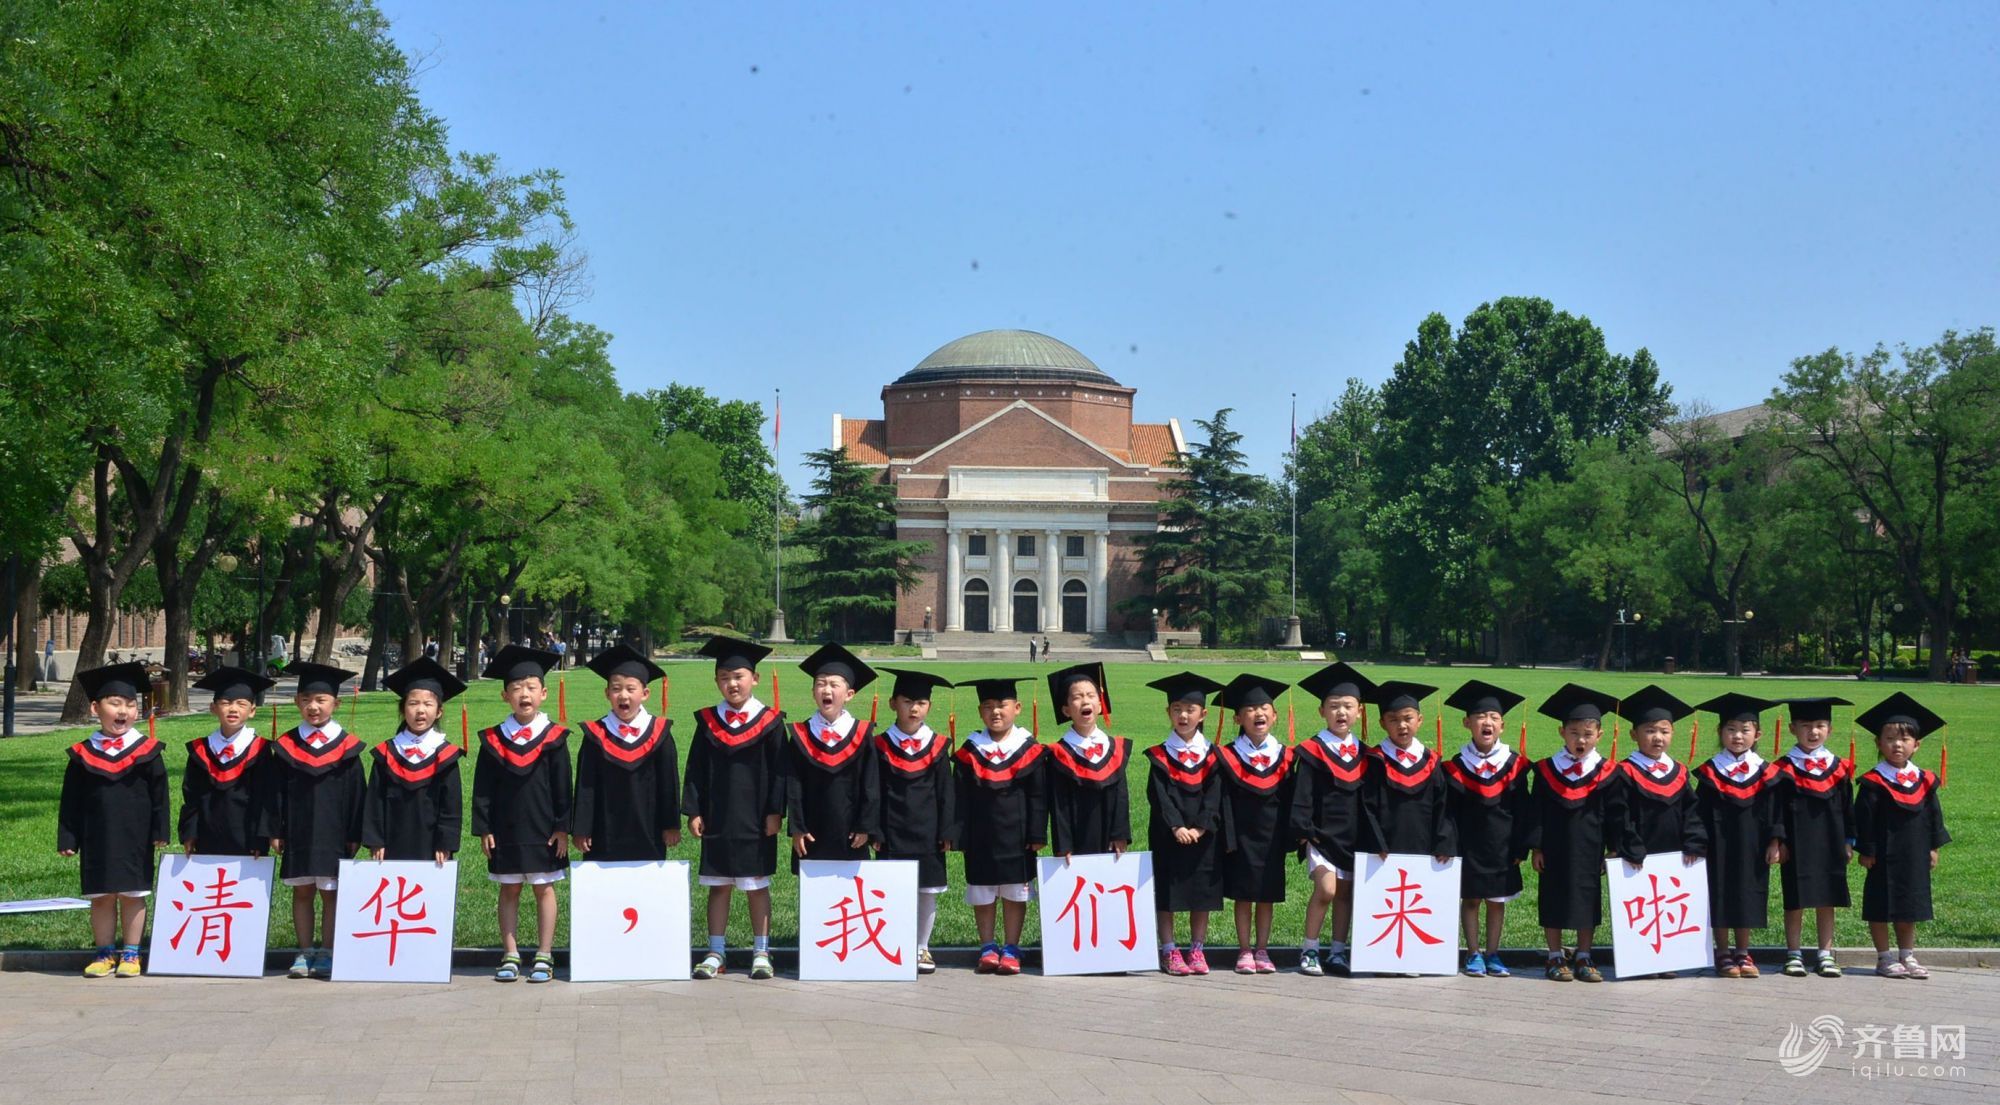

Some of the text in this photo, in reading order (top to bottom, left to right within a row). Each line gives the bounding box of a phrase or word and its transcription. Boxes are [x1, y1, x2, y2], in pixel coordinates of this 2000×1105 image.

[169, 867, 253, 961] 清
[353, 876, 437, 966] 华
[816, 875, 903, 966] 我
[1056, 875, 1137, 953] 们
[1367, 868, 1444, 959] 来
[1622, 874, 1701, 954] 啦
